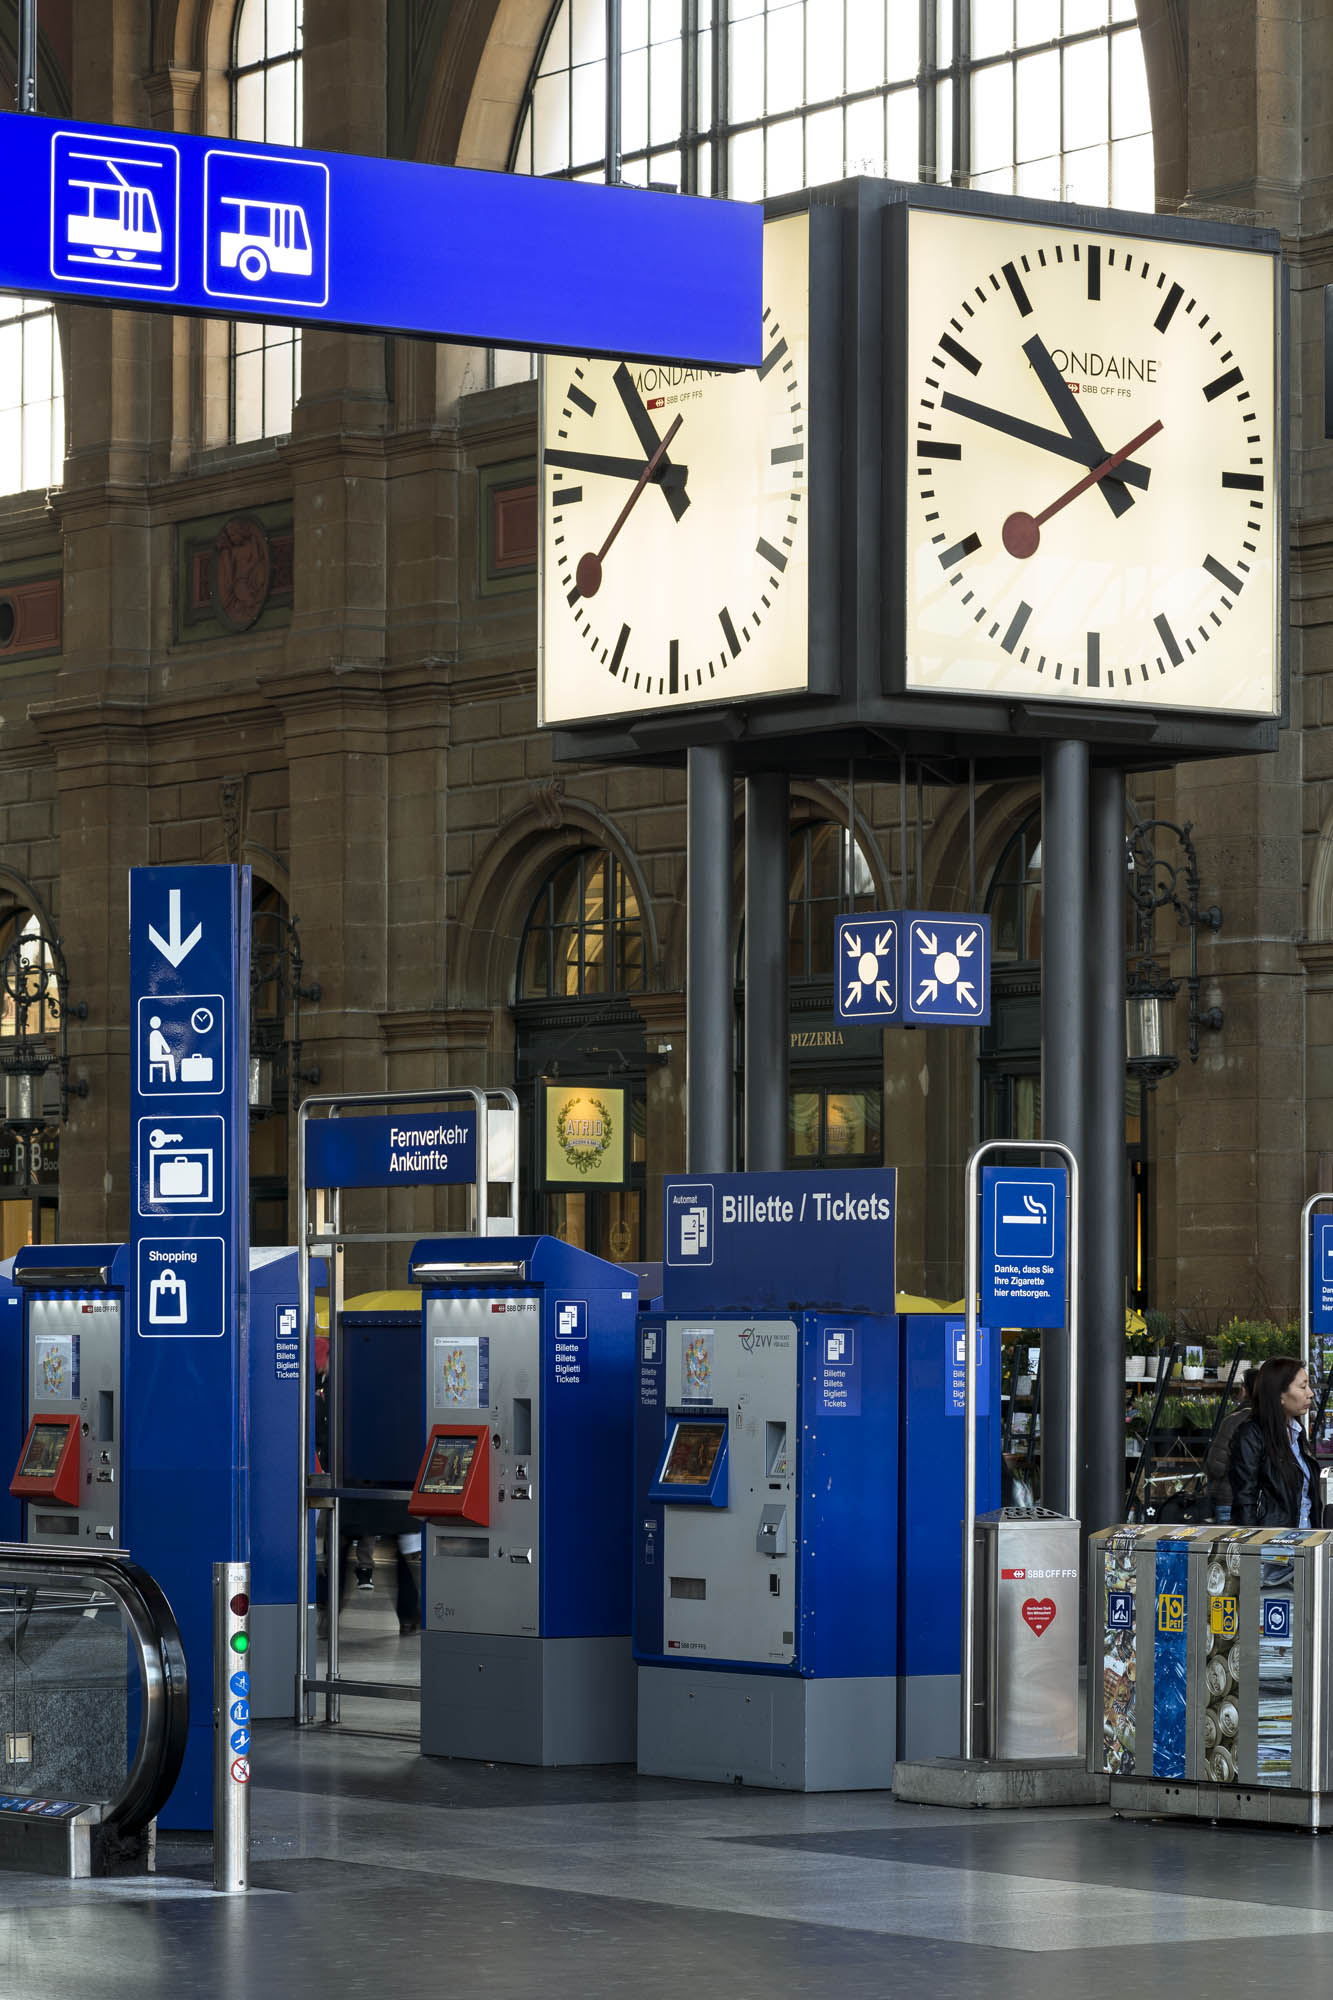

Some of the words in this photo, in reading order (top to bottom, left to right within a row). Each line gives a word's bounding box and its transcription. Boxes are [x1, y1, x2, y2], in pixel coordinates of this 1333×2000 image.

[1029, 349, 1157, 383] ONDAINE
[1082, 384, 1098, 394] SBB
[1100, 386, 1115, 396] CFF
[1117, 388, 1132, 398] FFS
[666, 395, 679, 405] SBB
[679, 392, 691, 402] CFF
[692, 390, 703, 399] FFS
[791, 1031, 844, 1048] PIZZERIA
[390, 1124, 469, 1148] Fernverkehr
[389, 1150, 448, 1172] Ankünfte
[672, 1195, 698, 1205] Automat
[722, 1194, 794, 1223] Billette
[799, 1193, 807, 1222] /
[812, 1192, 890, 1221] Tickets
[148, 1250, 198, 1263] Shopping
[994, 1264, 1021, 1274] Danke,
[1022, 1265, 1040, 1274] dass
[1041, 1265, 1054, 1274] Sie
[994, 1276, 1009, 1285] Ihre
[1010, 1276, 1045, 1287] Zigarette
[994, 1288, 1009, 1297] hier
[1010, 1288, 1051, 1299] entsorgen.
[506, 1304, 516, 1312] SBB
[517, 1304, 526, 1312] CFF
[527, 1304, 537, 1312] FFS
[755, 1335, 773, 1348] ZVV
[276, 1343, 298, 1351] Billette
[555, 1343, 579, 1352] Billette
[555, 1354, 576, 1362] Billets
[555, 1364, 581, 1374] Biglietti
[823, 1369, 846, 1378] Billette
[276, 1371, 299, 1379] Tickets
[555, 1375, 580, 1384] Tickets
[823, 1379, 843, 1388] Billets
[823, 1389, 848, 1399] Biglietti
[823, 1399, 847, 1408] Tickets
[1027, 1569, 1045, 1578] SBB
[1045, 1569, 1061, 1578] CFF
[1061, 1569, 1078, 1578] FFS
[1169, 1619, 1181, 1629] PET
